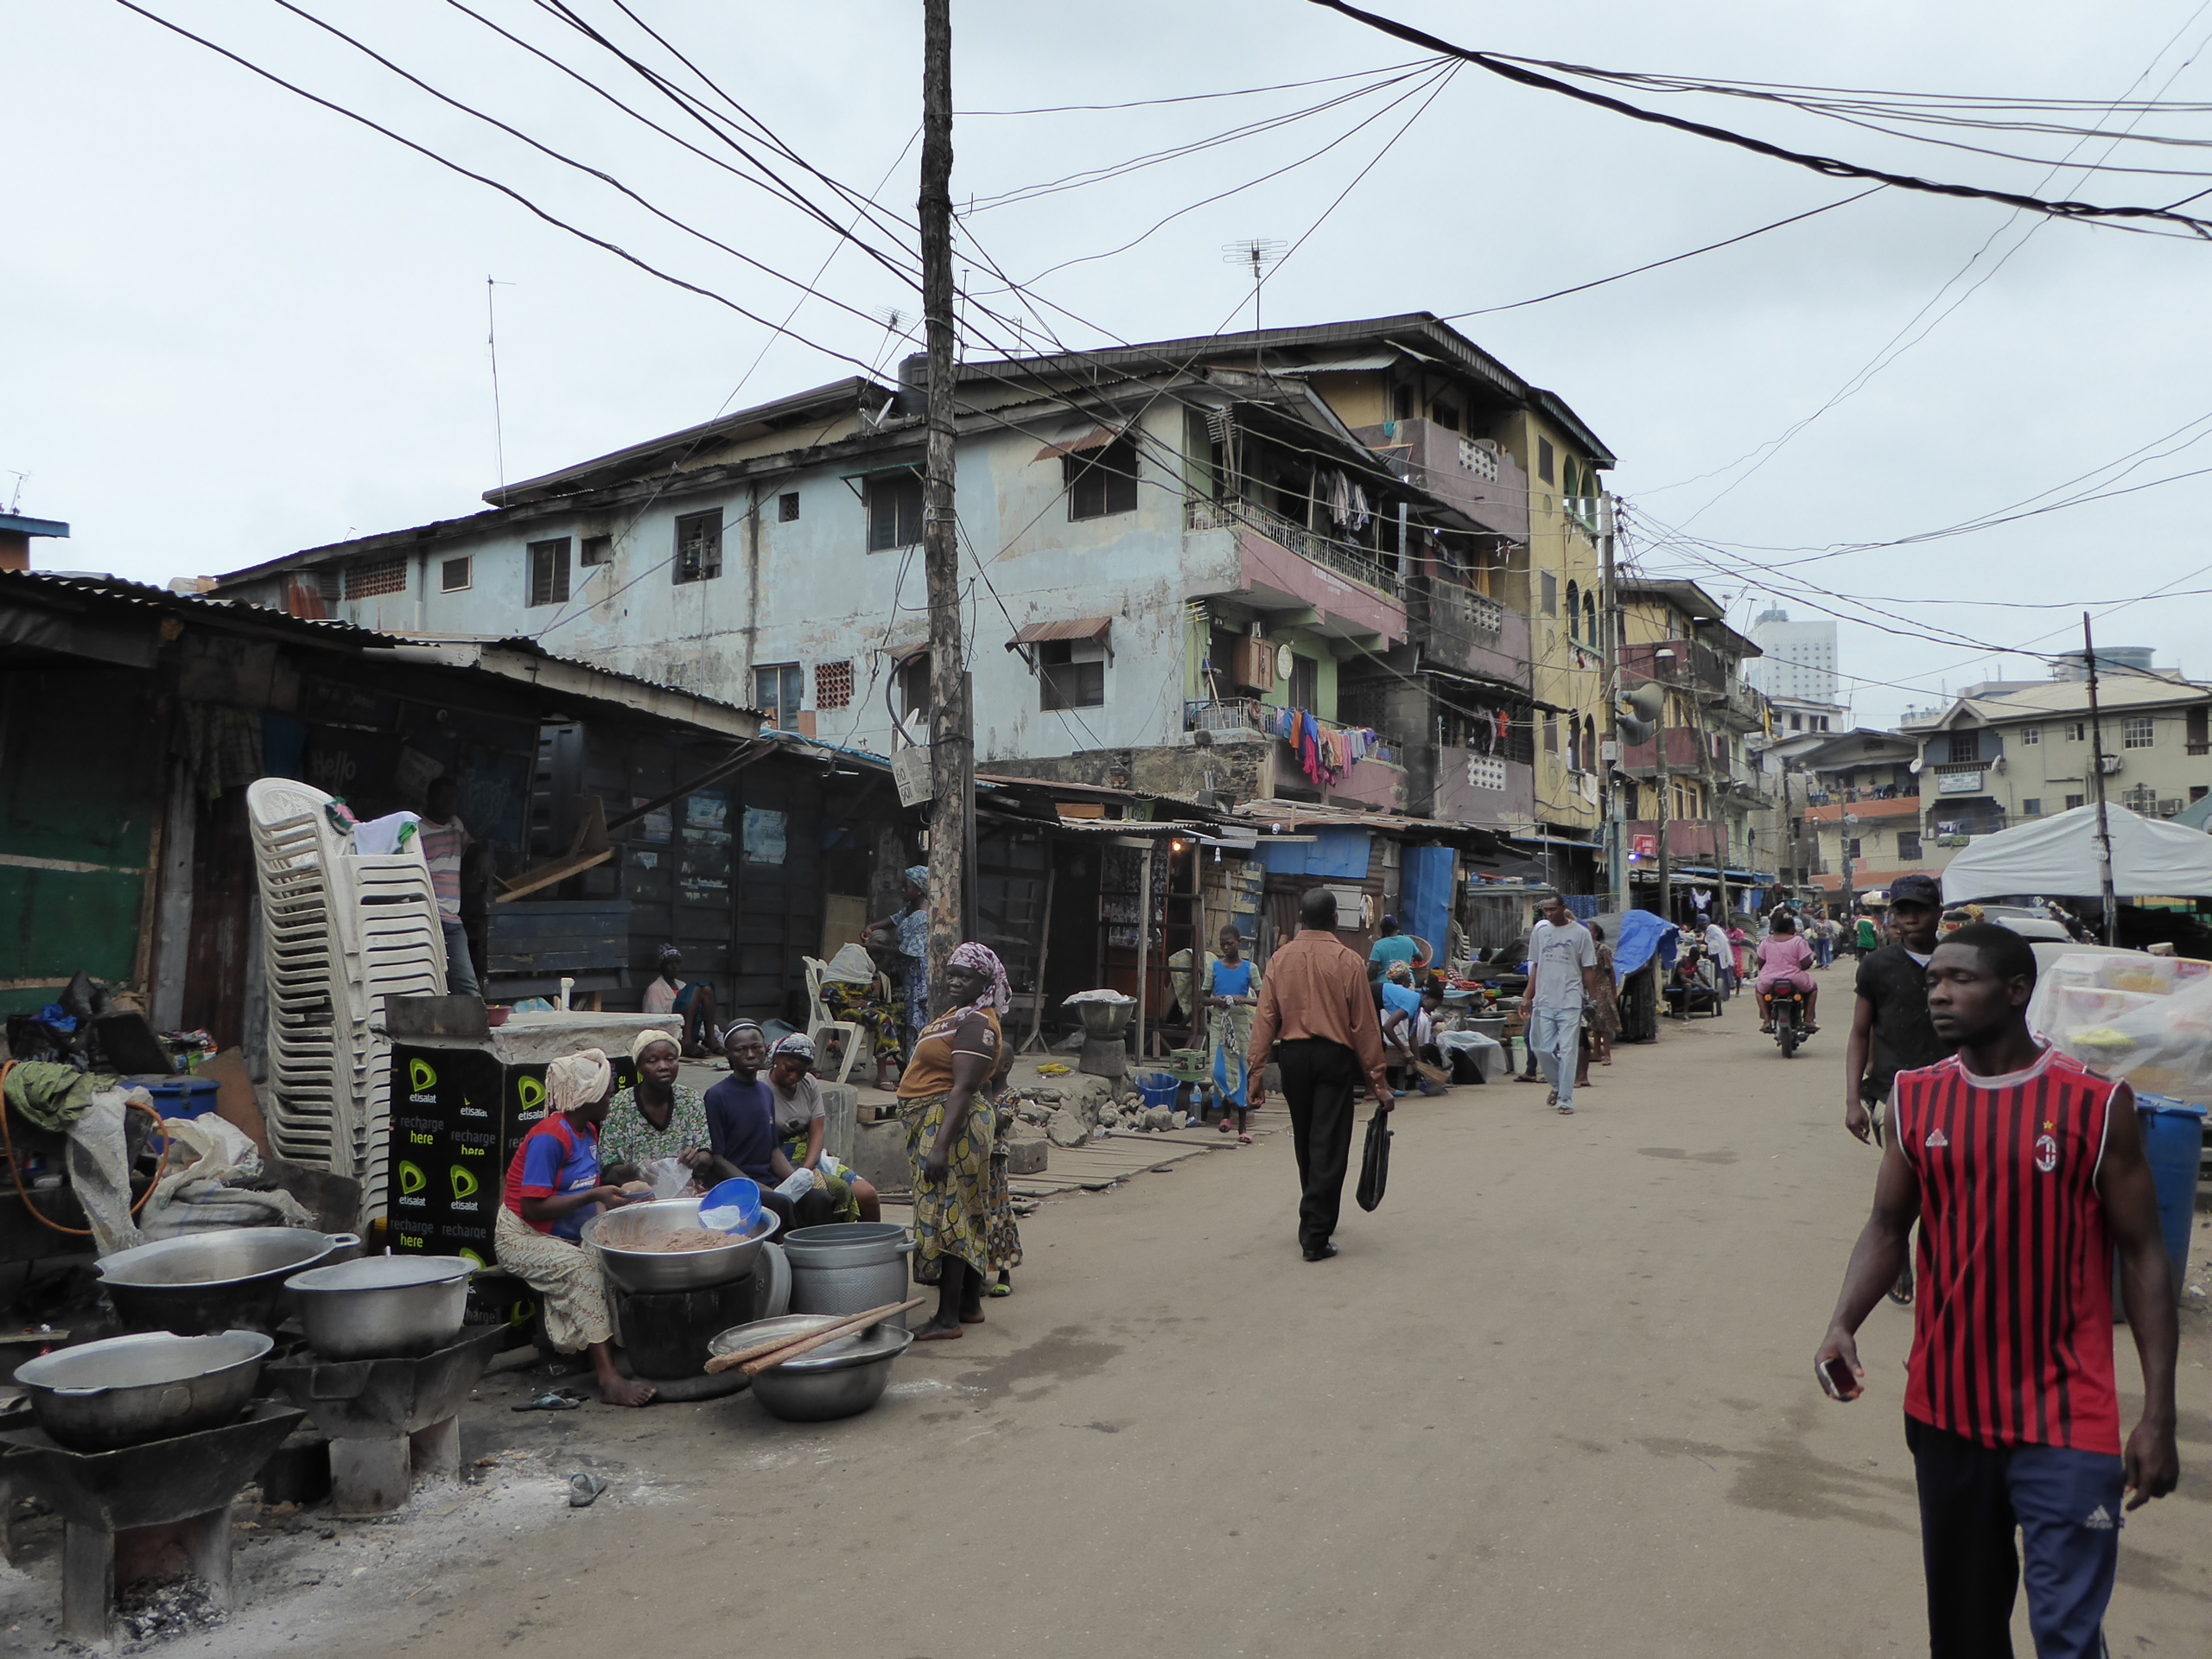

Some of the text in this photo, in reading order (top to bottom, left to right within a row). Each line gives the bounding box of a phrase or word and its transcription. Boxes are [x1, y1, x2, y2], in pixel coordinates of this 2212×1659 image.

[409, 1093, 437, 1103] etisalat
[400, 1116, 445, 1131] recharge
[410, 1130, 434, 1145] here
[451, 1128, 496, 1147] recharge
[398, 1195, 427, 1207] etisalat
[450, 1200, 479, 1211] etisalat
[390, 1218, 434, 1236] recharge
[400, 1232, 424, 1249] here
